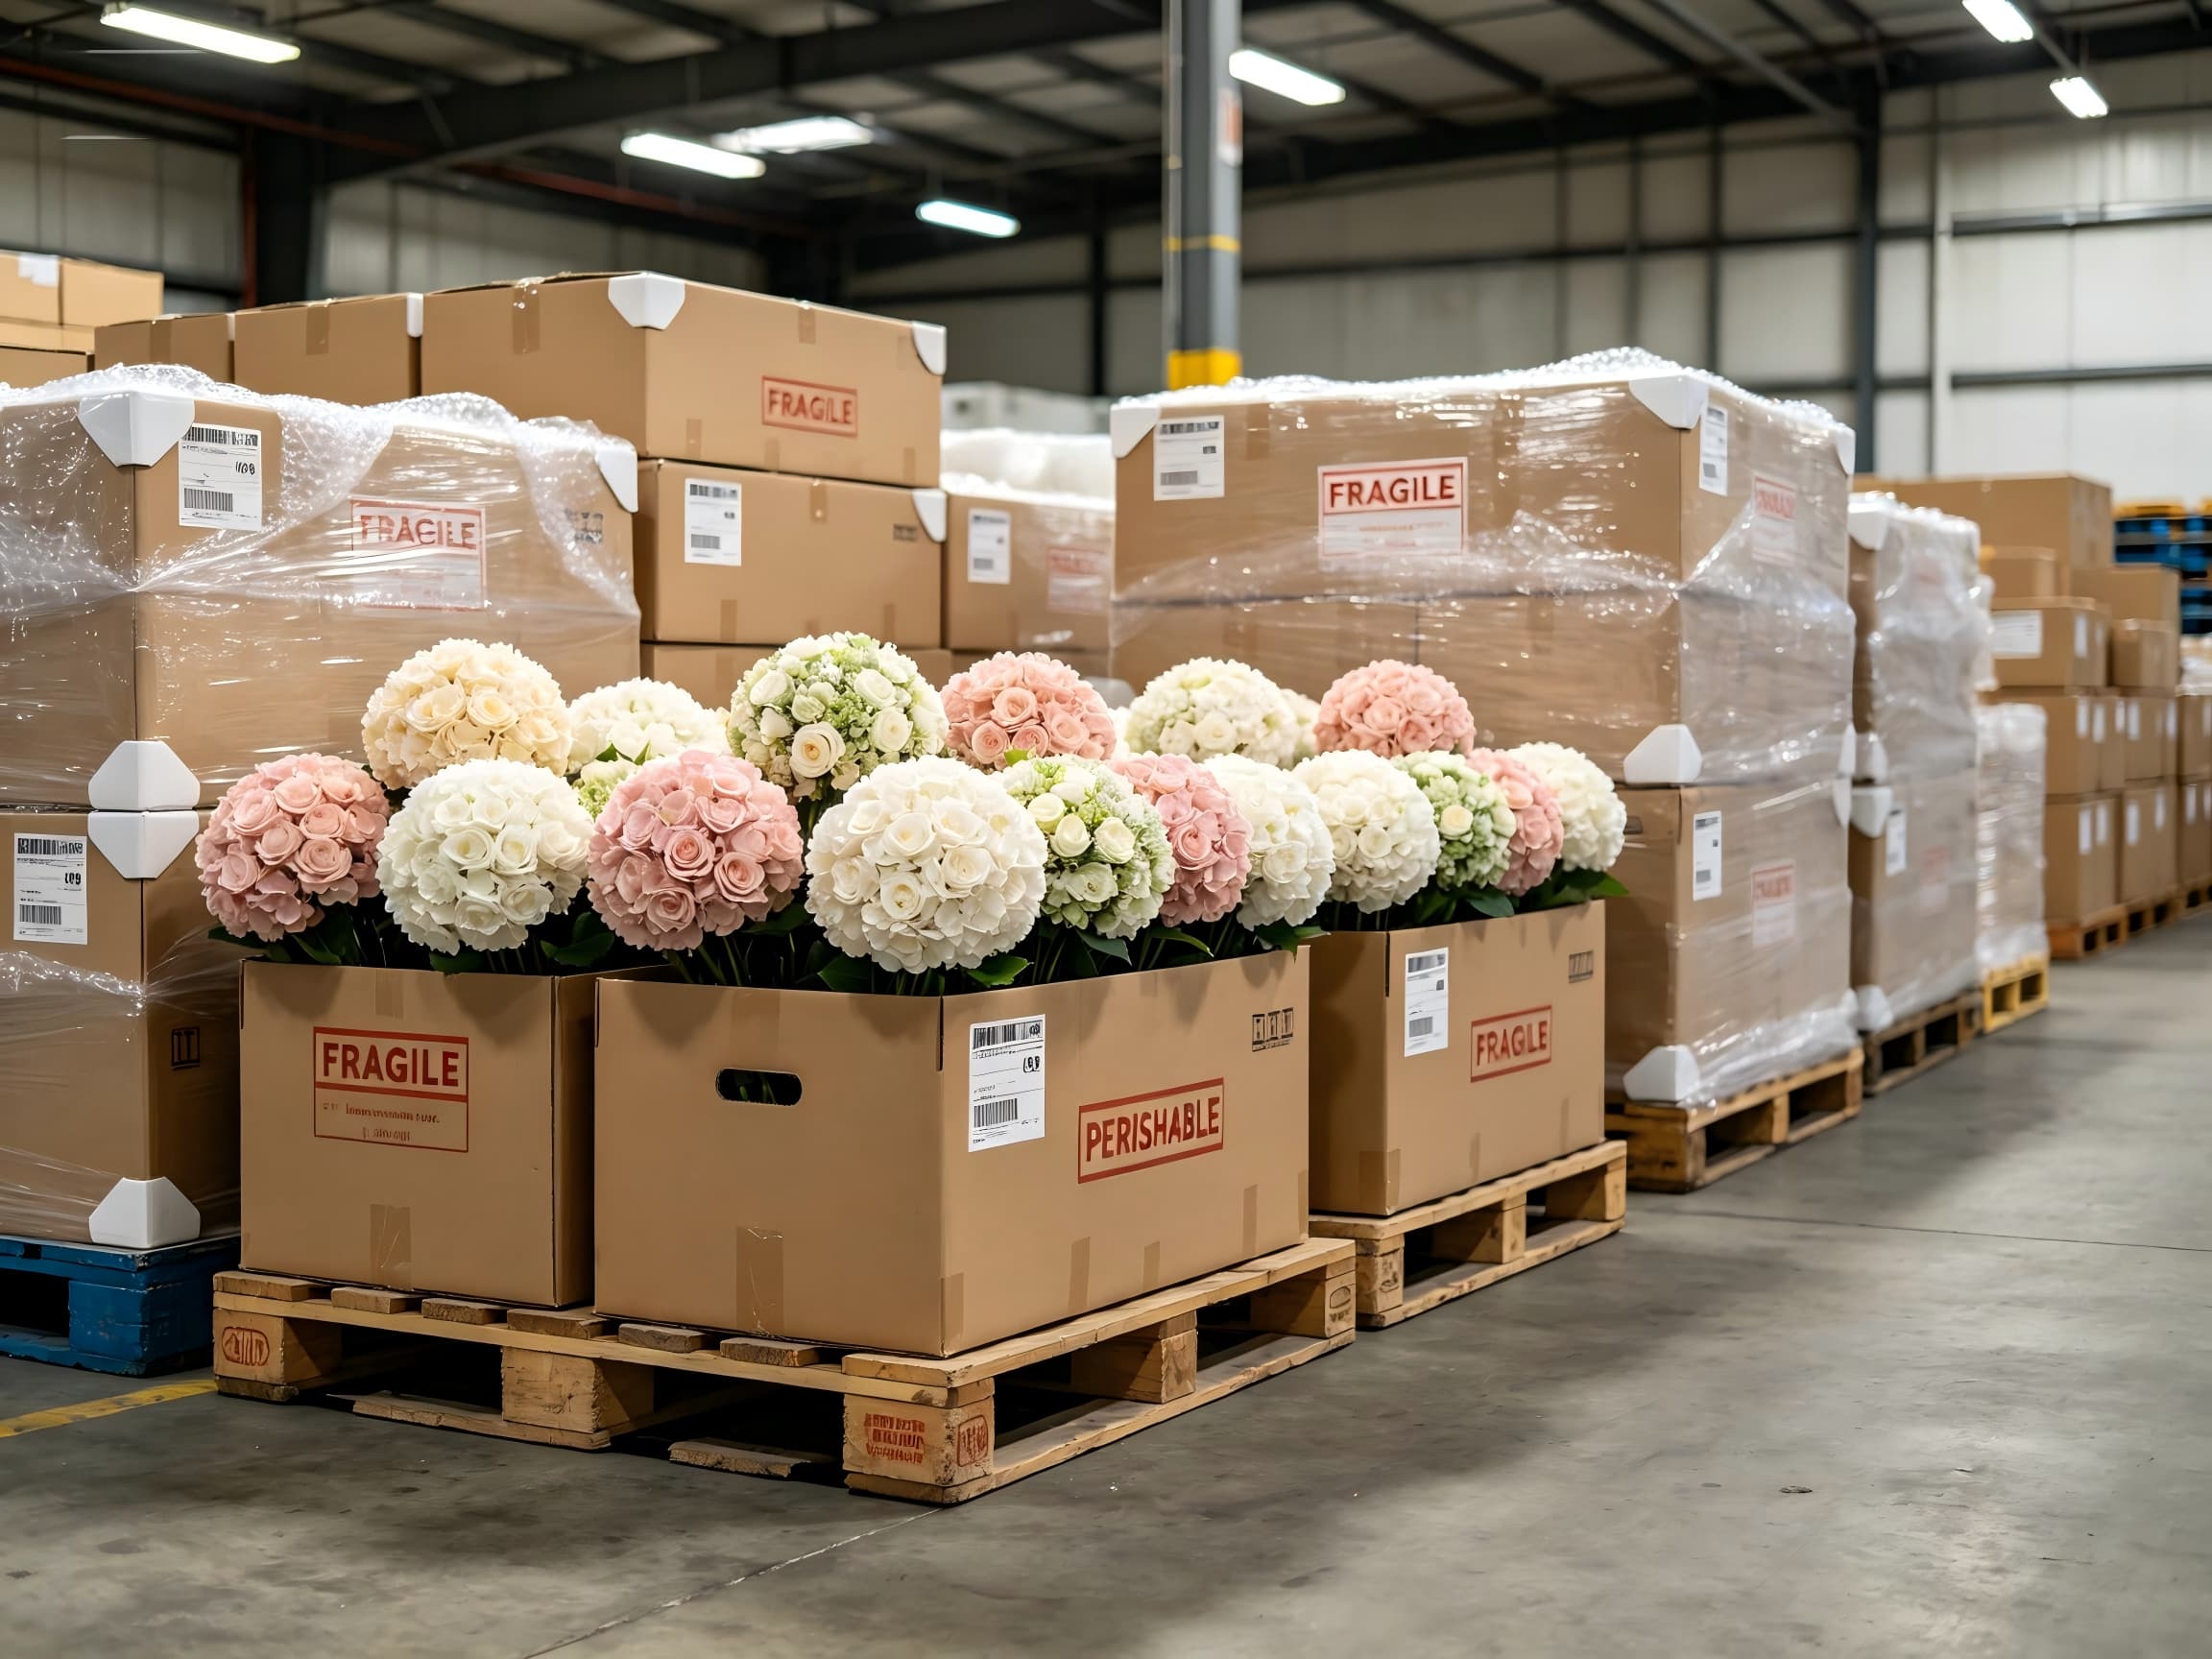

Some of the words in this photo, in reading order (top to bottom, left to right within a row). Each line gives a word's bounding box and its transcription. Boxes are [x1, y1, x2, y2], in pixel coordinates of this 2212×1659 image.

[768, 388, 853, 423] FRAGILE
[1330, 475, 1455, 508] FRAGILE
[360, 515, 477, 550] FRAGILE
[323, 1042, 459, 1087] FRAGILE
[1086, 1096, 1220, 1163] PERISHABLE
